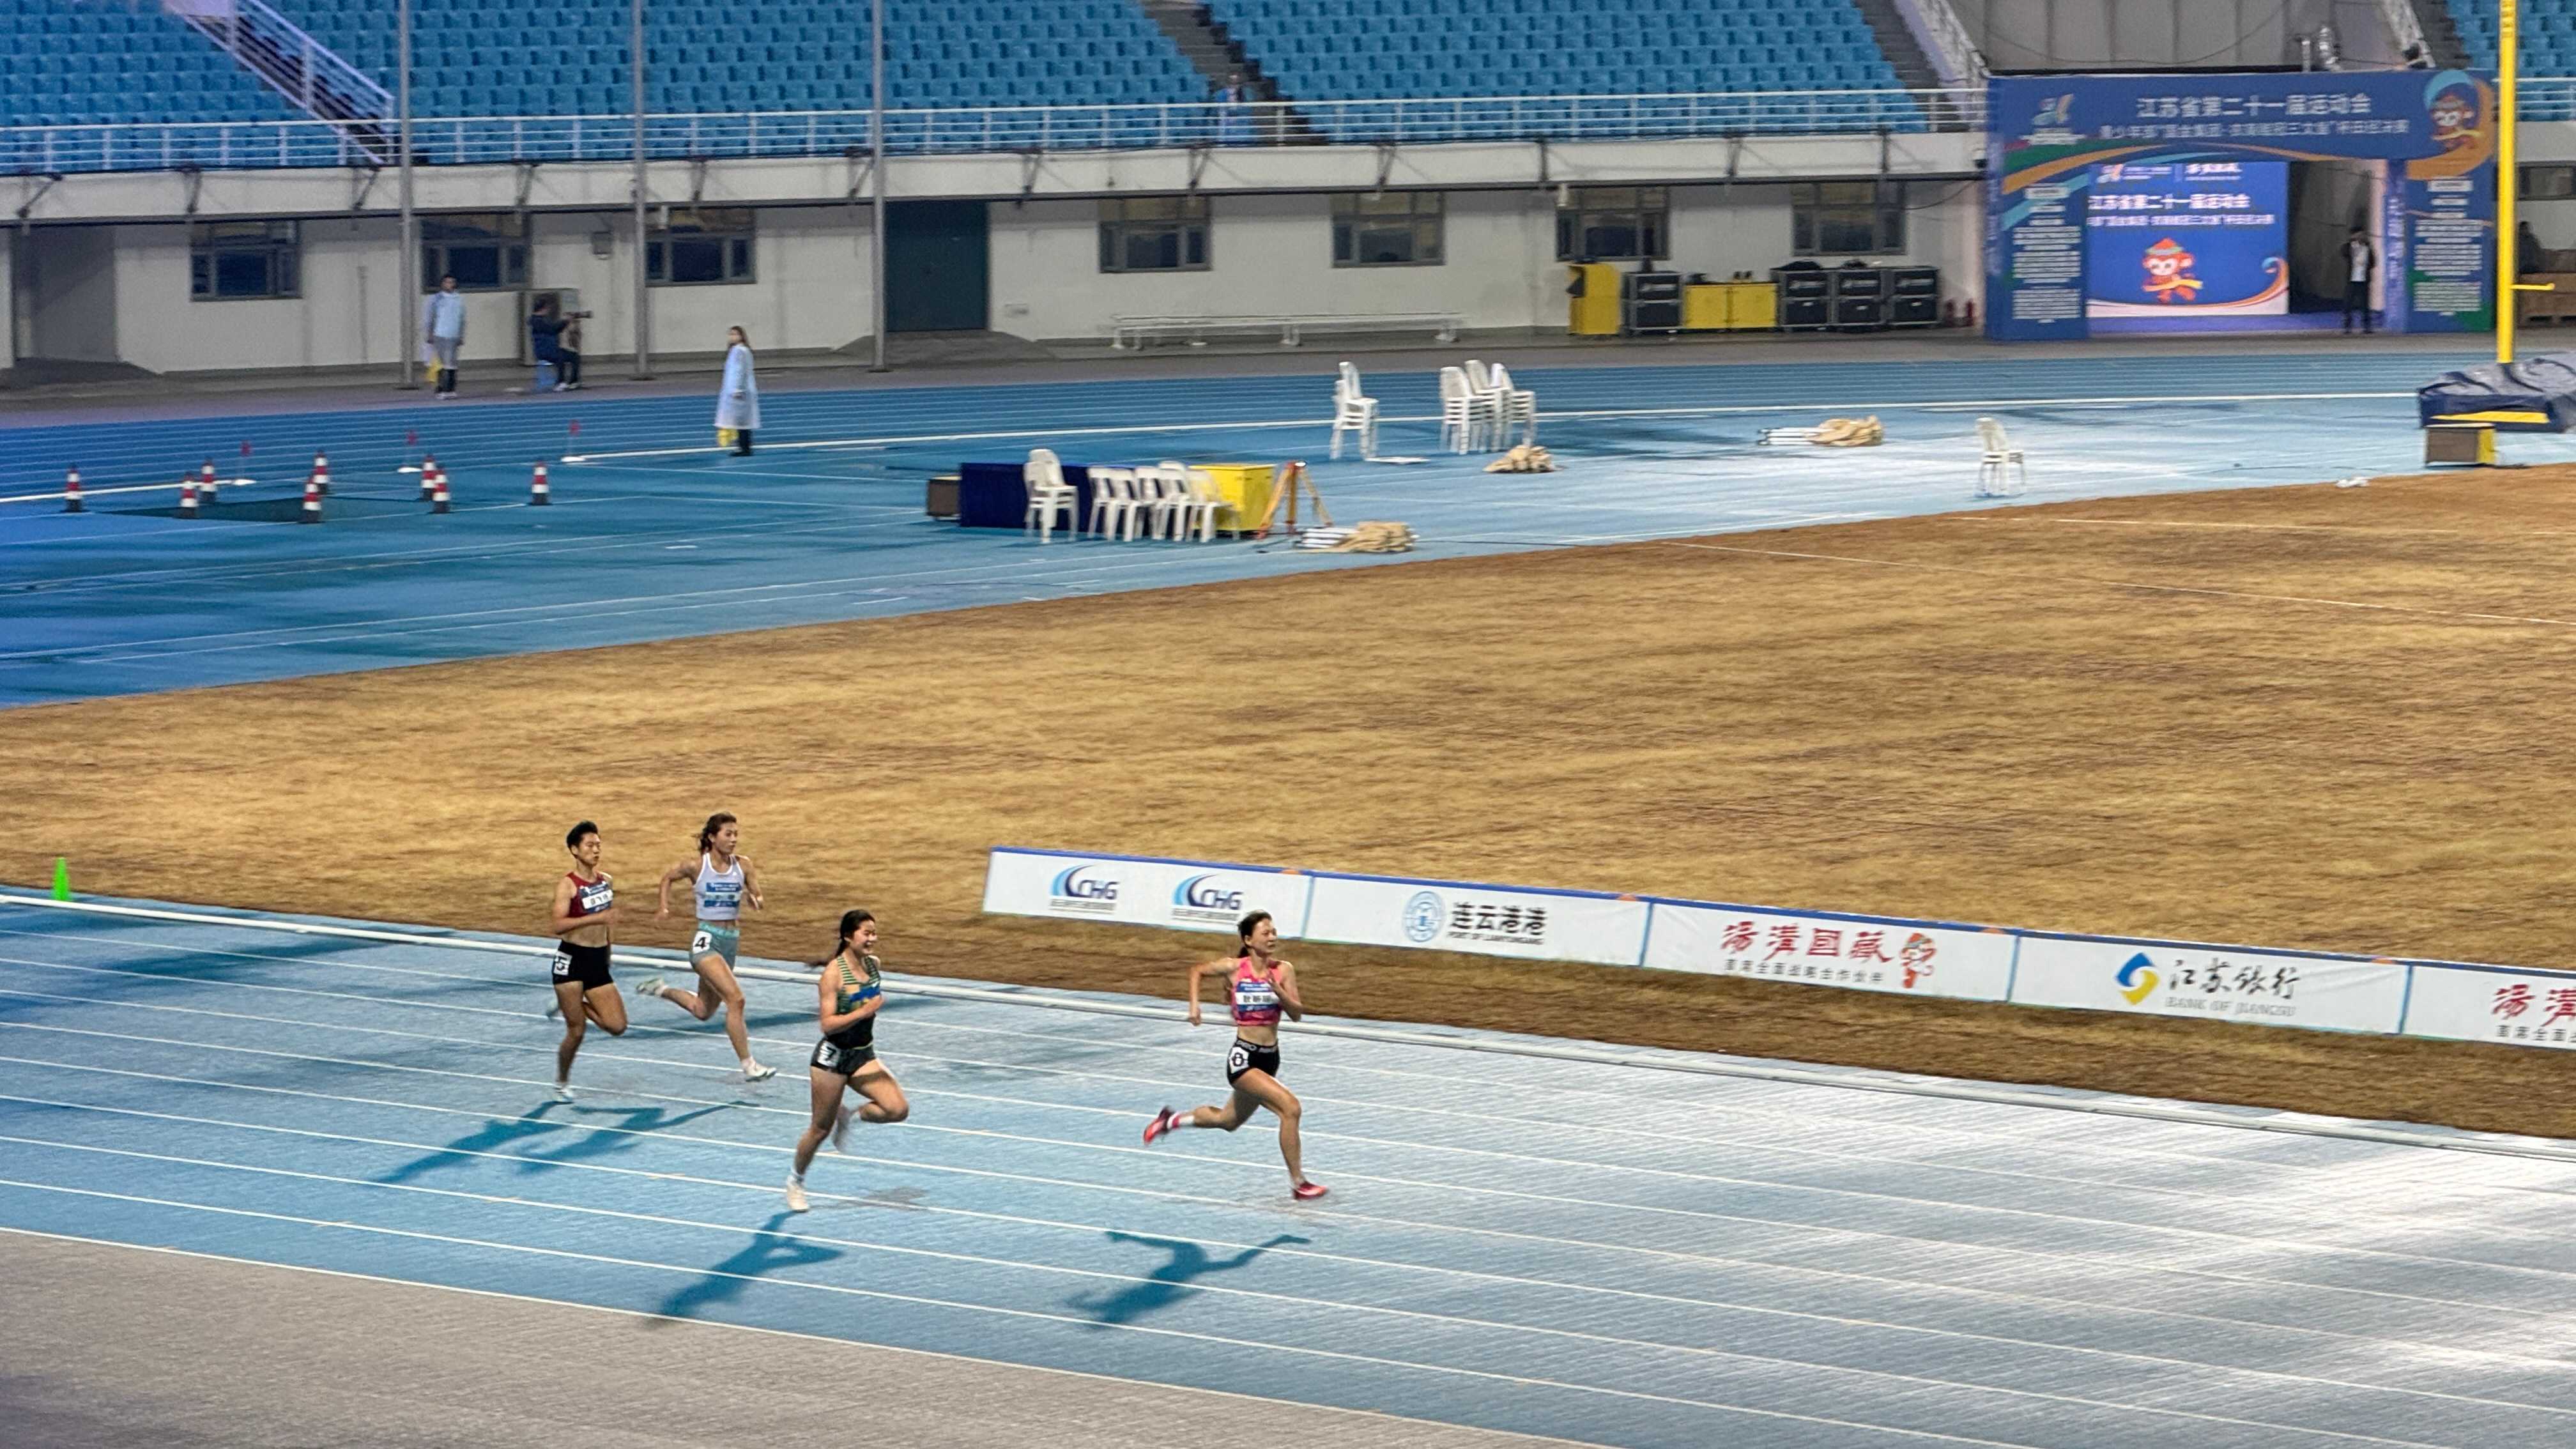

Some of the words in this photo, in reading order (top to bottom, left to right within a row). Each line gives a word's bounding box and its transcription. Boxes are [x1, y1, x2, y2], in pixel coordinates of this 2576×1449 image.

[1077, 879, 1120, 900] CHG
[1200, 889, 1243, 910] CHG
[694, 937, 707, 949] 4
[1231, 1052, 1245, 1067] 8
